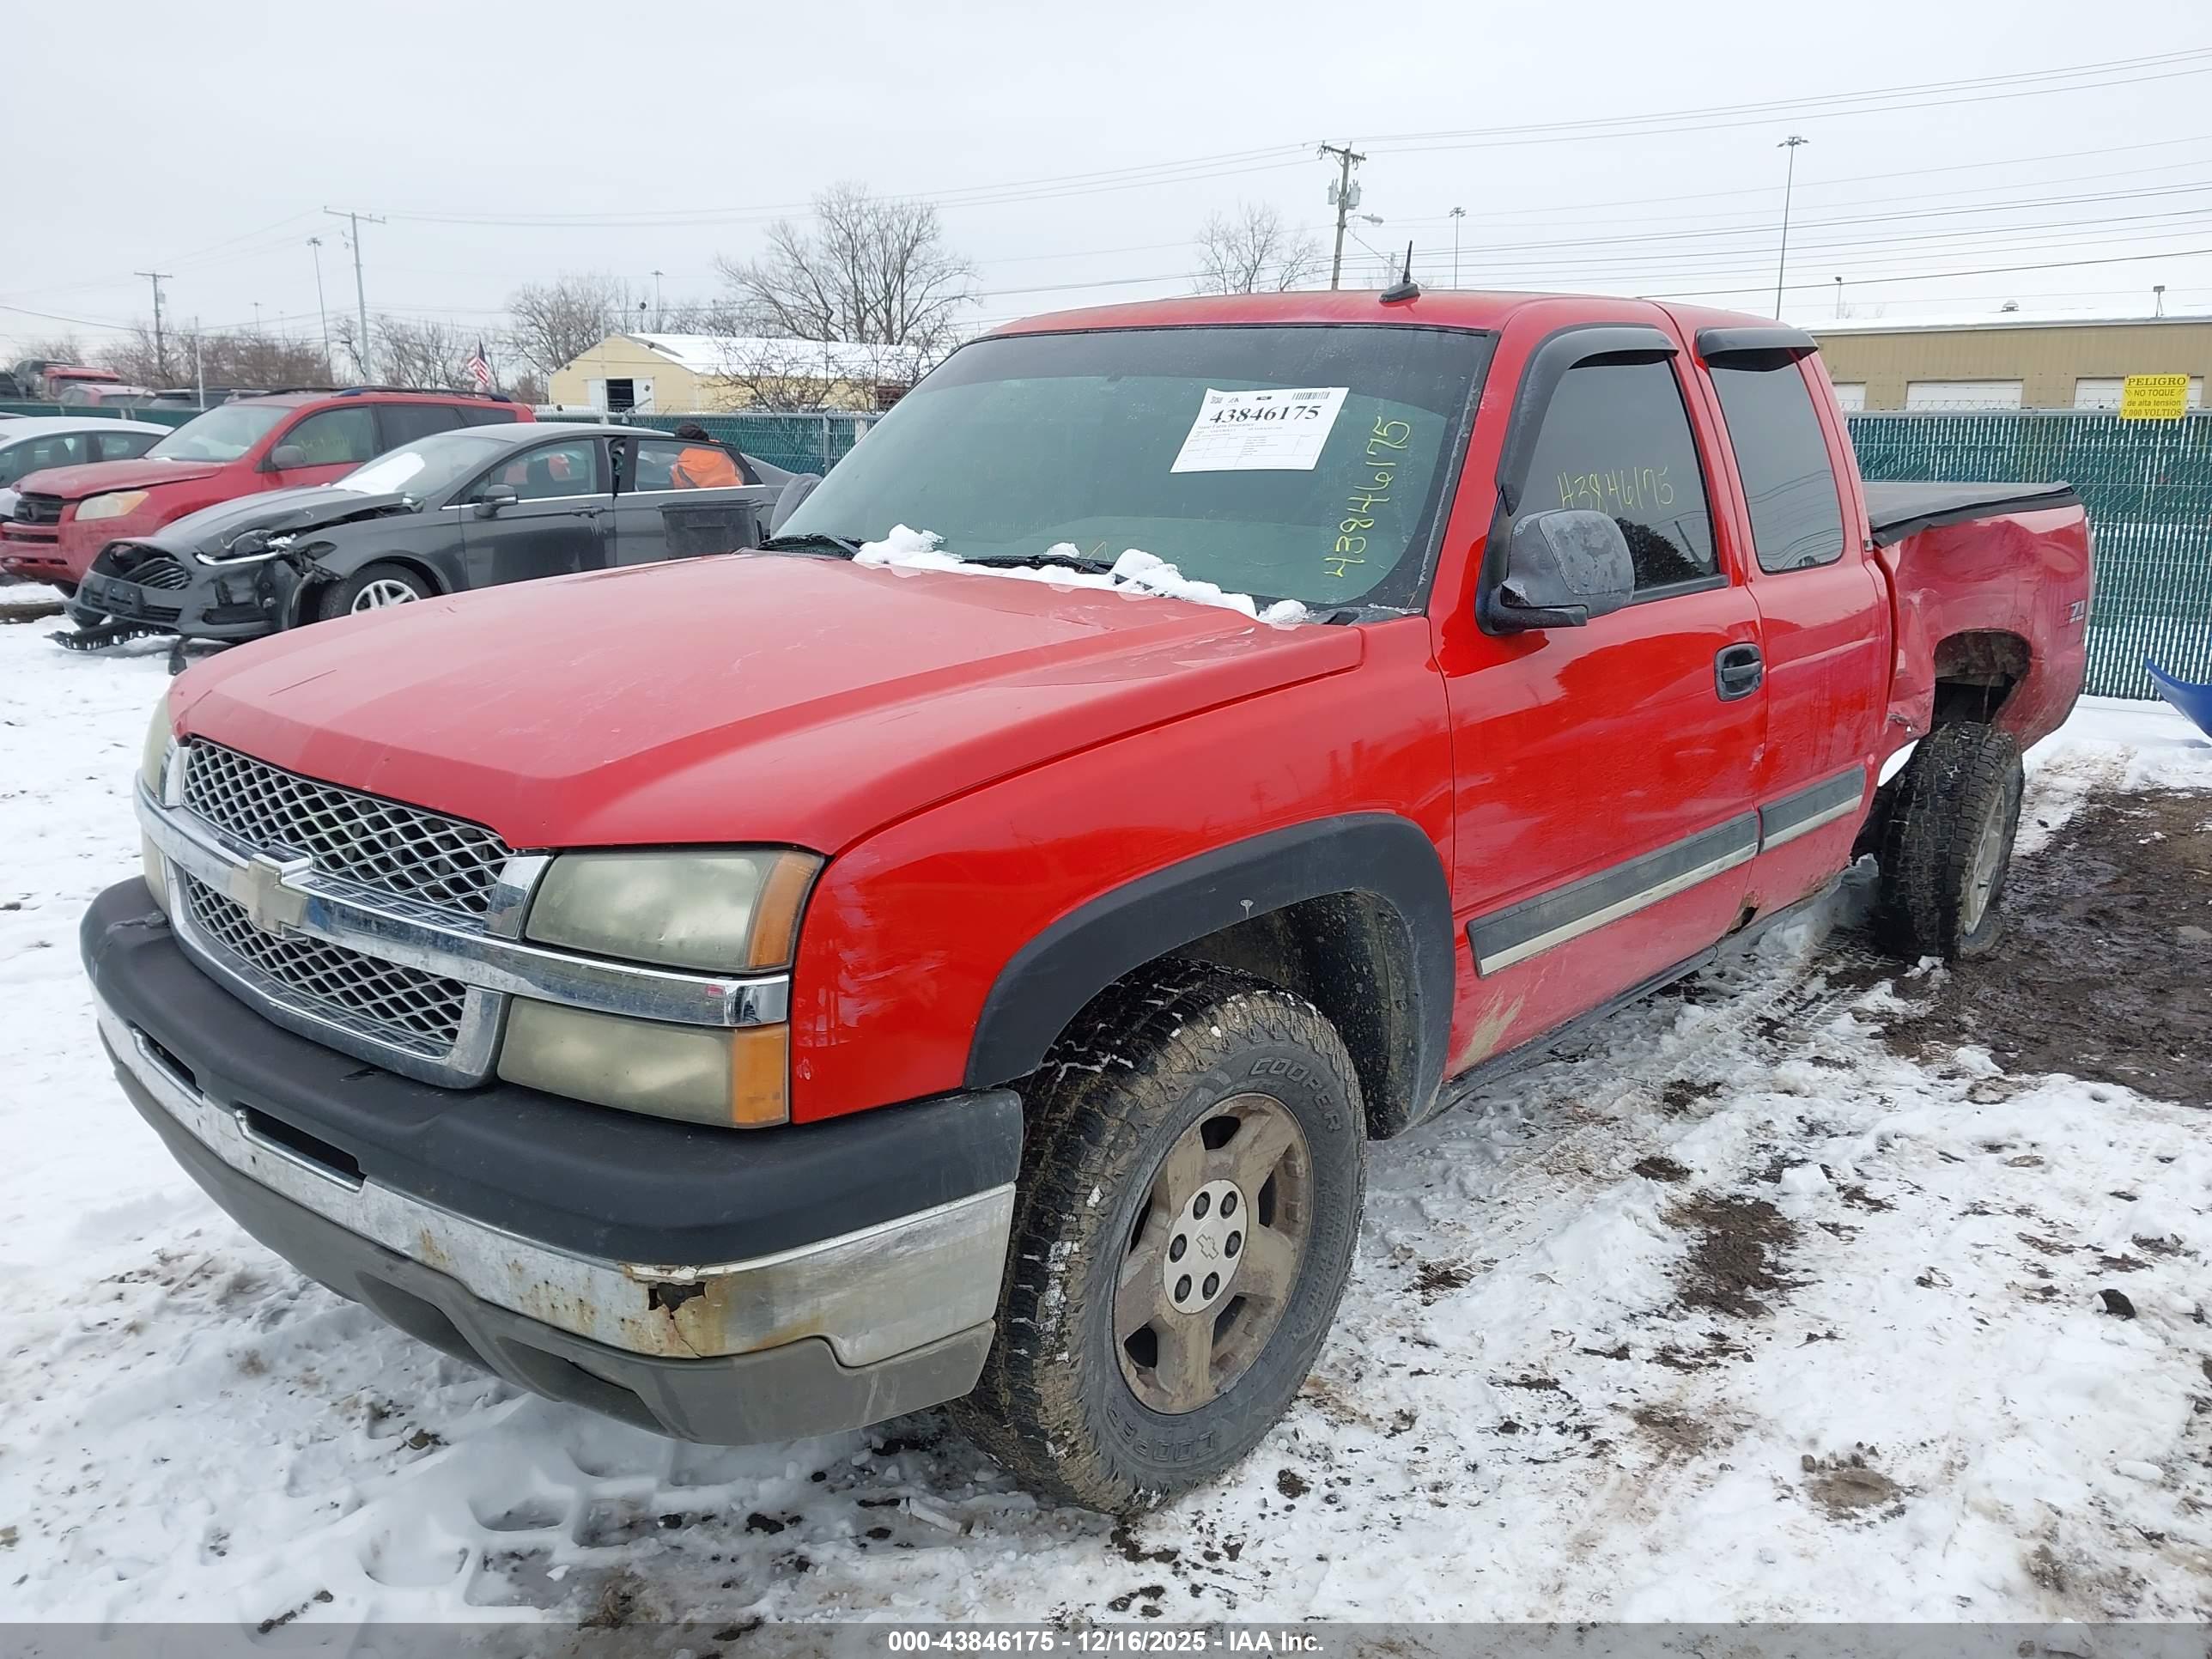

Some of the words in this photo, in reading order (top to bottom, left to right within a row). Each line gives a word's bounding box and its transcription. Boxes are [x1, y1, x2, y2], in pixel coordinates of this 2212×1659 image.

[2128, 377, 2186, 386] PELIGRO
[1209, 404, 1322, 424] 43846175
[2143, 408, 2183, 416] VOLTIOS
[1322, 416, 1411, 578] 43846175
[1249, 1056, 1342, 1132] COOPER
